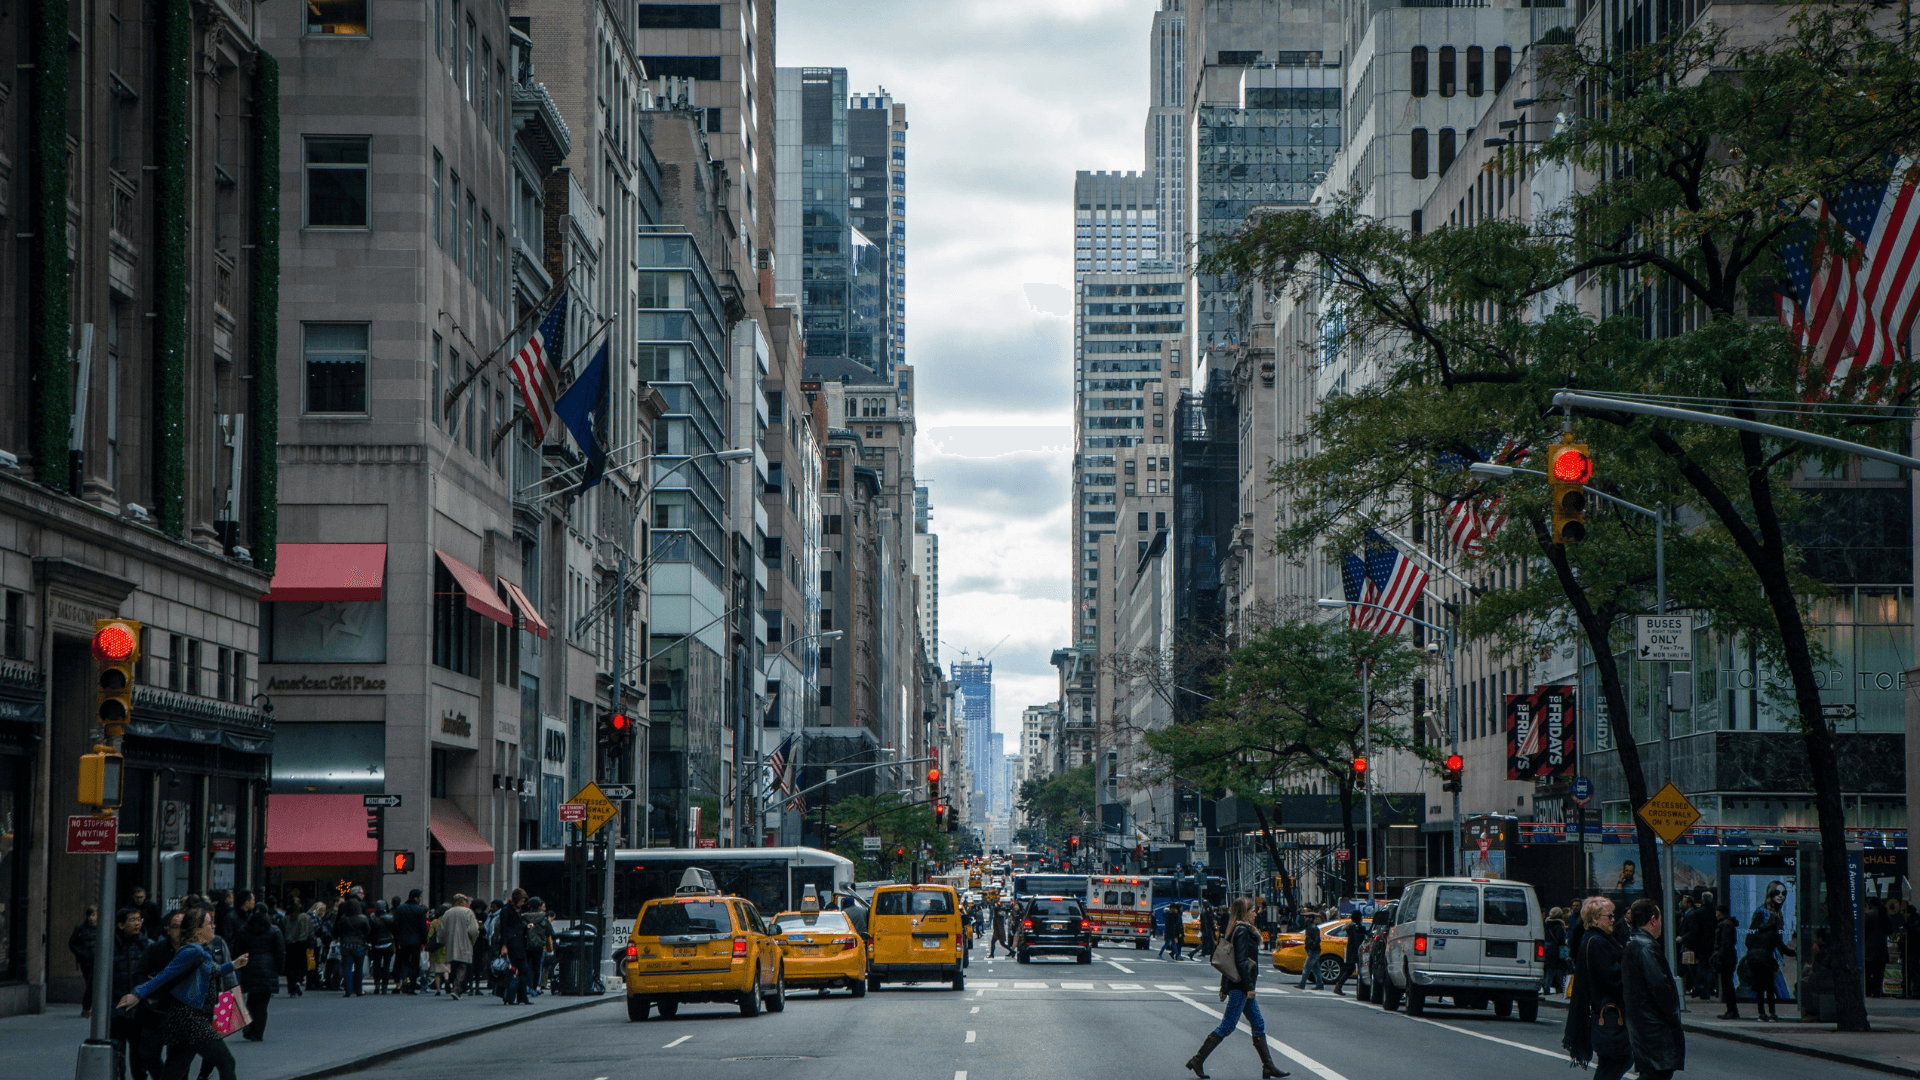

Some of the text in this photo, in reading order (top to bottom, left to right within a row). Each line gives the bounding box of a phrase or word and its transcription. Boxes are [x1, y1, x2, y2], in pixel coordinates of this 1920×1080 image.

[1647, 619, 1682, 629] BUSES
[1651, 635, 1679, 644] ONLY
[266, 674, 386, 690] American Girl Place
[1549, 695, 1562, 703] TGI
[1548, 703, 1563, 766] FRIDAYS
[545, 728, 566, 764] ALDO
[1651, 801, 1689, 810] RECESSED
[1648, 810, 1691, 819] CROSSWALK
[71, 819, 114, 828] NO STOPPING
[1665, 819, 1671, 827] 5
[1674, 819, 1688, 827] AVE
[76, 829, 109, 838] ANYTIME
